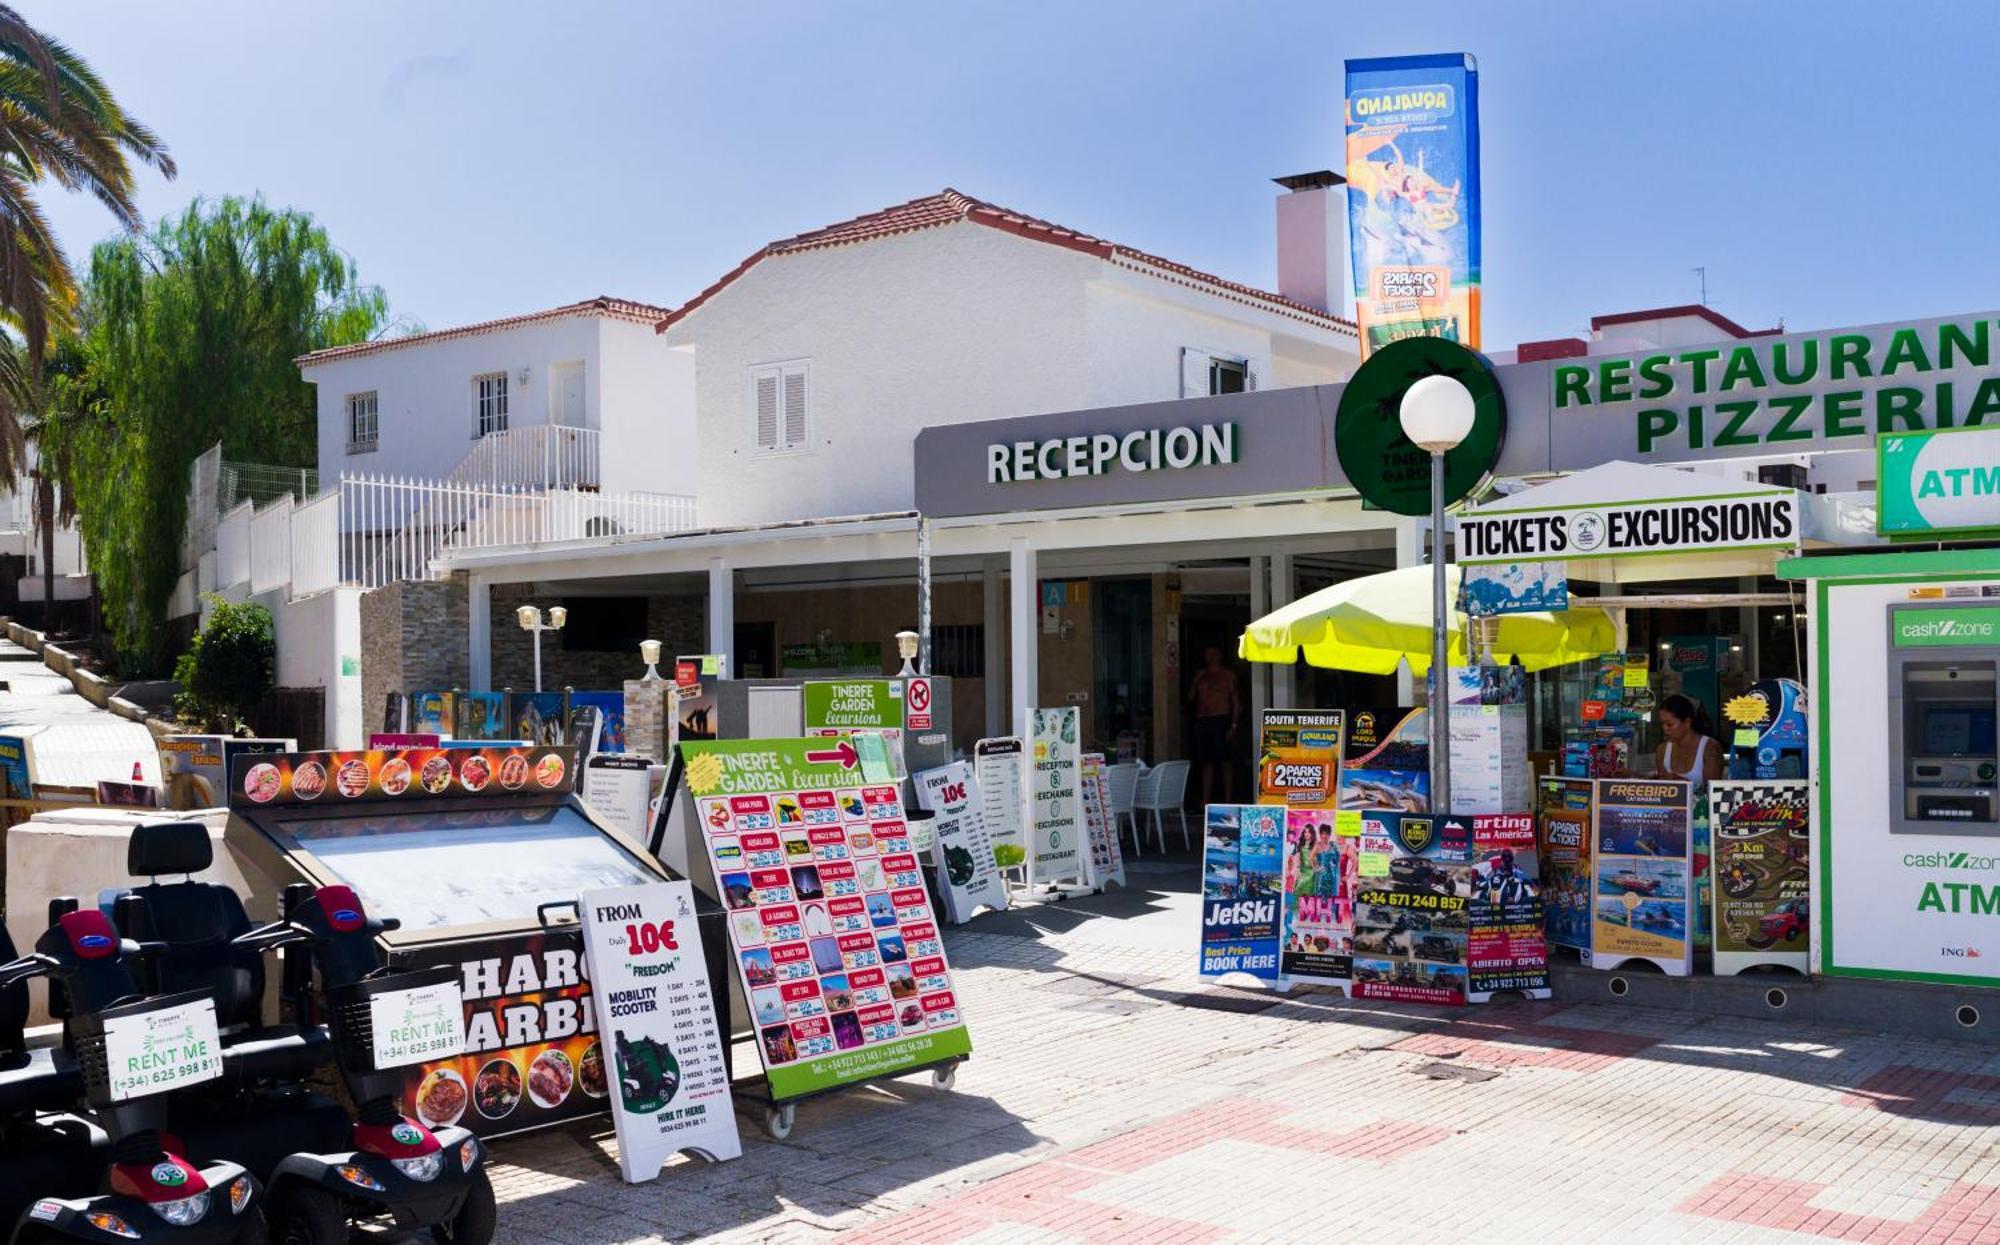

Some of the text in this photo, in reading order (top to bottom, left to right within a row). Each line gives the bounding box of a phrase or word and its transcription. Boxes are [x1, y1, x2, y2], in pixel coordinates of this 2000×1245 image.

[1554, 318, 2000, 408] RESTAURAN
[987, 422, 1234, 484] RECEPCION
[1918, 466, 2000, 500] ATM
[1607, 500, 1793, 549] EXCURSIONS
[1461, 515, 1568, 557] TICKETS
[831, 685, 874, 698] TINERFE
[831, 698, 875, 711] GARDEN
[824, 710, 881, 725] Excursions
[1264, 715, 1339, 725] SOUTH TENERIFE
[717, 752, 781, 772] TINERFE
[1037, 760, 1074, 771] RECEPTION
[719, 768, 866, 792] GARDEN Excursion
[927, 775, 949, 789] FROM
[1274, 764, 1322, 787] 2 PARKS
[1286, 776, 1322, 787] TICKET
[941, 782, 968, 804] 10€
[1038, 788, 1074, 801] EXCHANGE
[1609, 784, 1679, 798] FREEBIRD
[1038, 817, 1074, 831] EXCURSIONS
[1473, 815, 1532, 830] arting
[1557, 821, 1581, 835] PARKS
[1557, 834, 1581, 846] TICKET
[1743, 841, 1765, 853] Km
[1038, 849, 1075, 862] RESTAURANT
[1361, 890, 1387, 905] +34
[1388, 892, 1410, 907] 671
[1440, 896, 1465, 911] 857
[1917, 881, 2000, 916] ATM
[596, 903, 642, 923] FROM
[1205, 900, 1275, 927] JetSki
[625, 920, 679, 956] 10€
[1941, 947, 1965, 958] ING
[1204, 955, 1239, 972] BOOK
[1242, 954, 1277, 969] HERE
[1471, 957, 1545, 968] ABIERTO OPEN
[608, 986, 657, 1005] MOBILITY
[610, 1000, 658, 1018] SCOOTER
[390, 1019, 453, 1043] RENT ME
[128, 1040, 208, 1072] RENT ME
[379, 1046, 407, 1062] (+34)
[410, 1041, 428, 1054] 625
[114, 1056, 220, 1093] (+34) 625 998 811
[657, 1104, 707, 1124] HIRE IT HERE!
